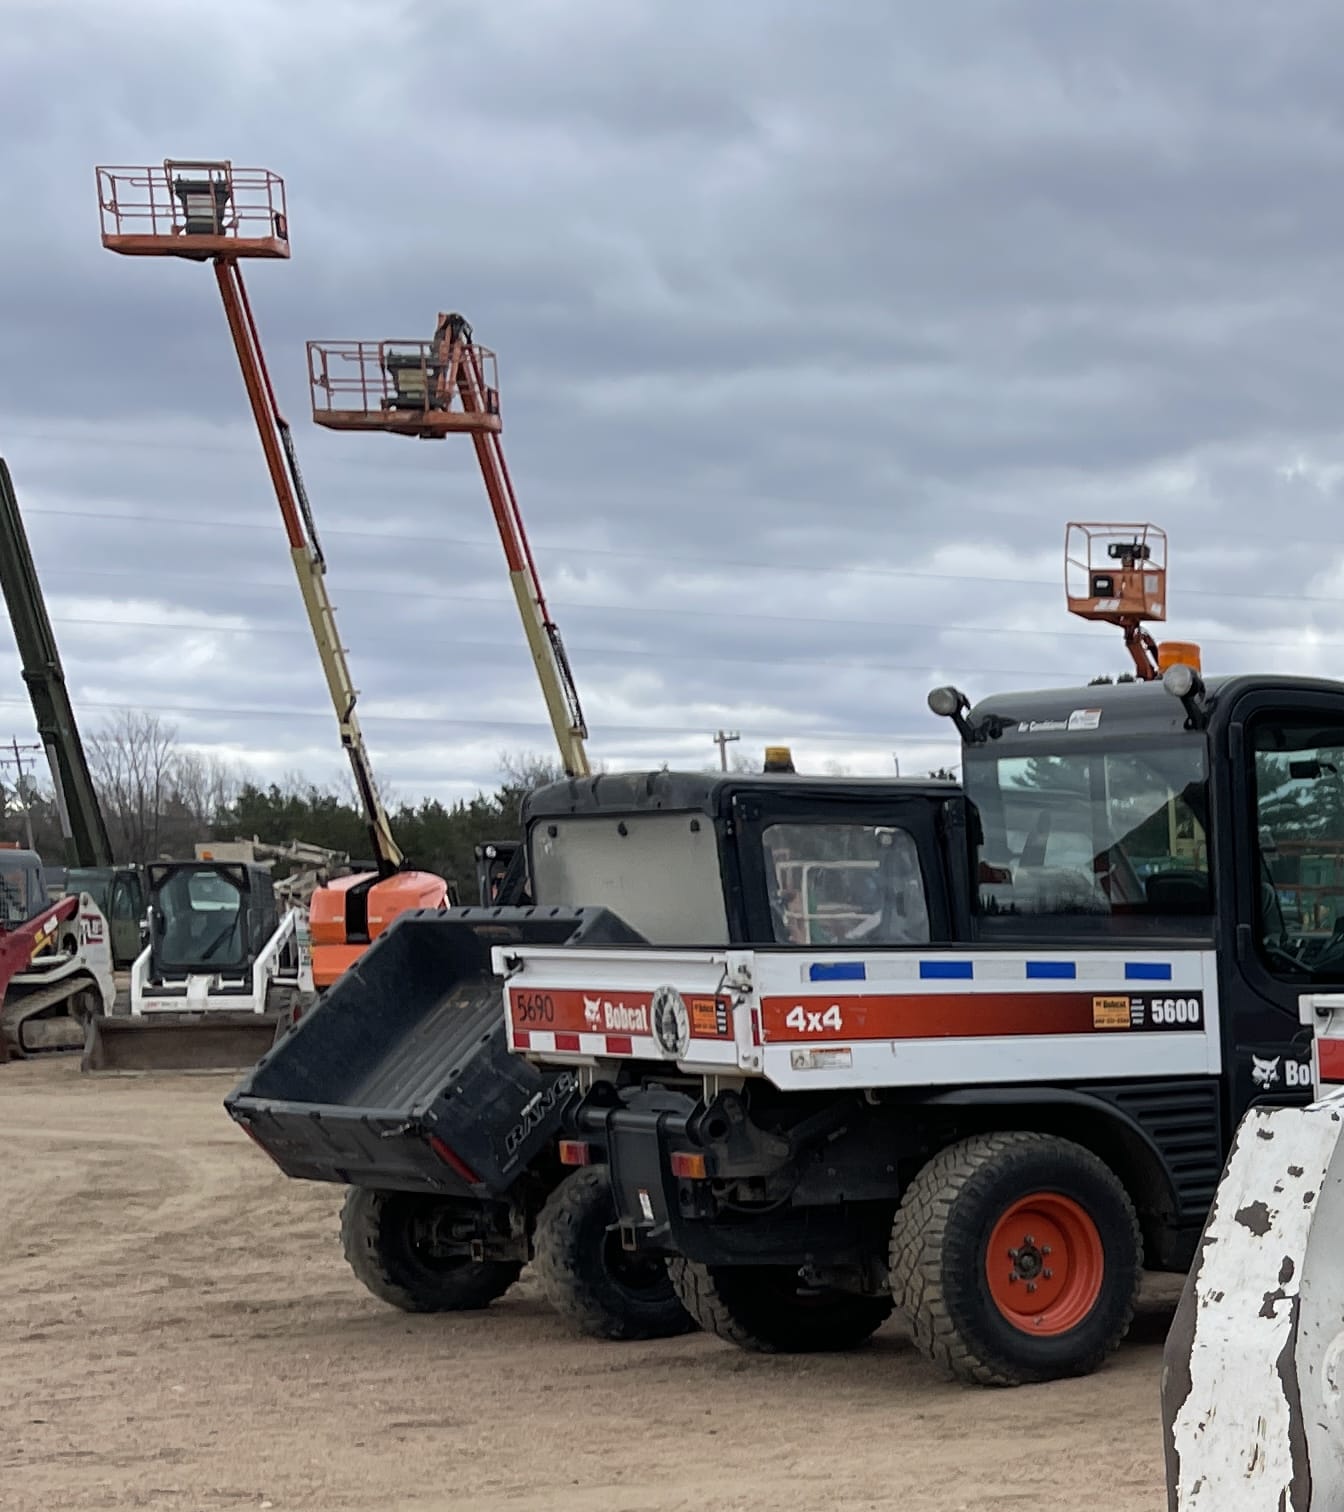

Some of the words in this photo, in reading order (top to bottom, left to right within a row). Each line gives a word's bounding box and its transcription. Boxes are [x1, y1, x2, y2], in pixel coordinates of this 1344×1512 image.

[517, 994, 553, 1022] 5690
[604, 1001, 648, 1031] Bobcat
[785, 1004, 843, 1032] 4x4
[1151, 998, 1199, 1023] 5600
